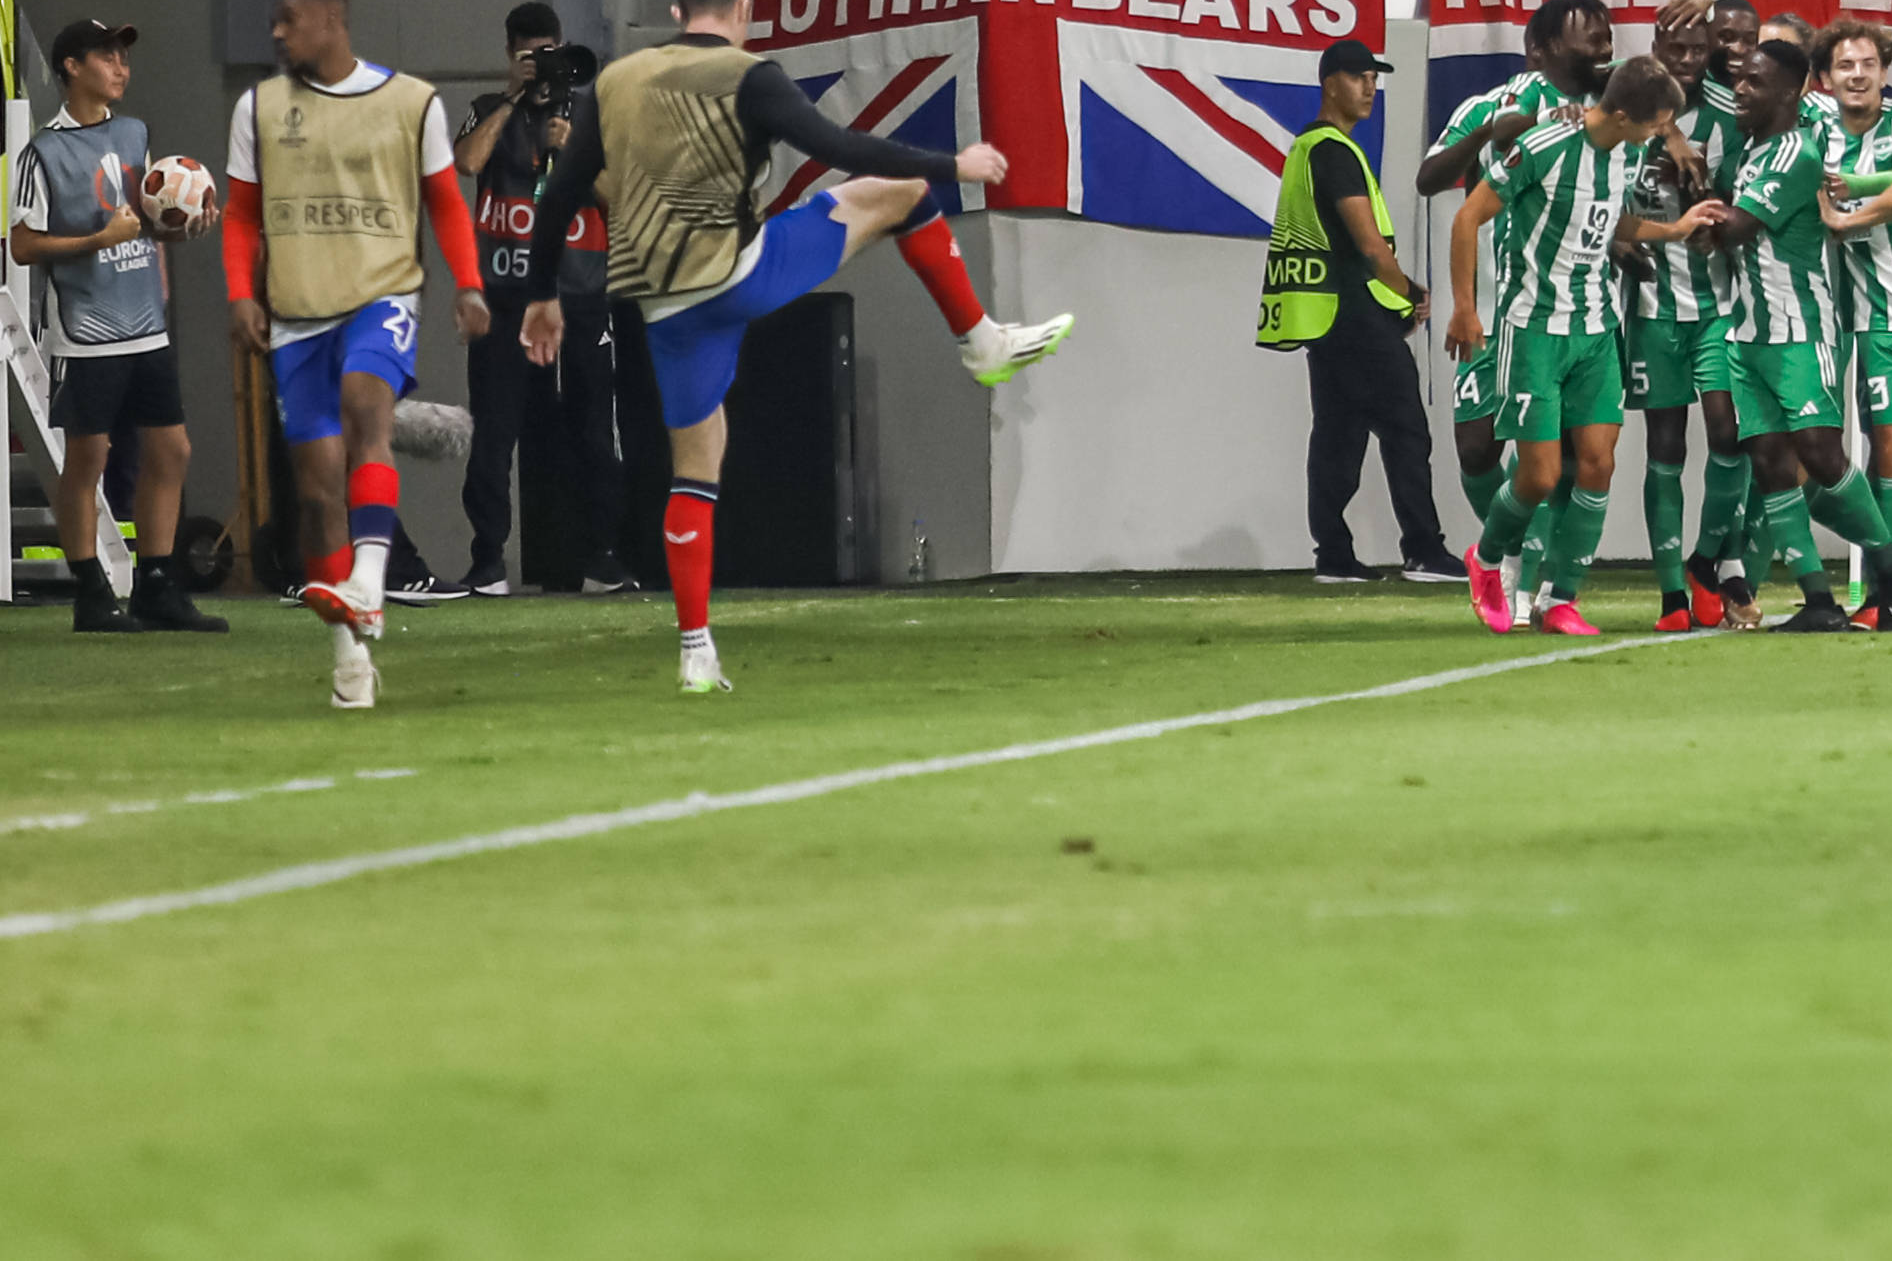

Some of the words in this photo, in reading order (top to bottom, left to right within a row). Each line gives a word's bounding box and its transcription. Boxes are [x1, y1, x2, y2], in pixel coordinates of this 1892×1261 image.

[304, 203, 398, 229] RESPEC
[114, 256, 150, 273] LEAGUE
[491, 247, 530, 278] 05
[1515, 393, 1532, 426] 7
